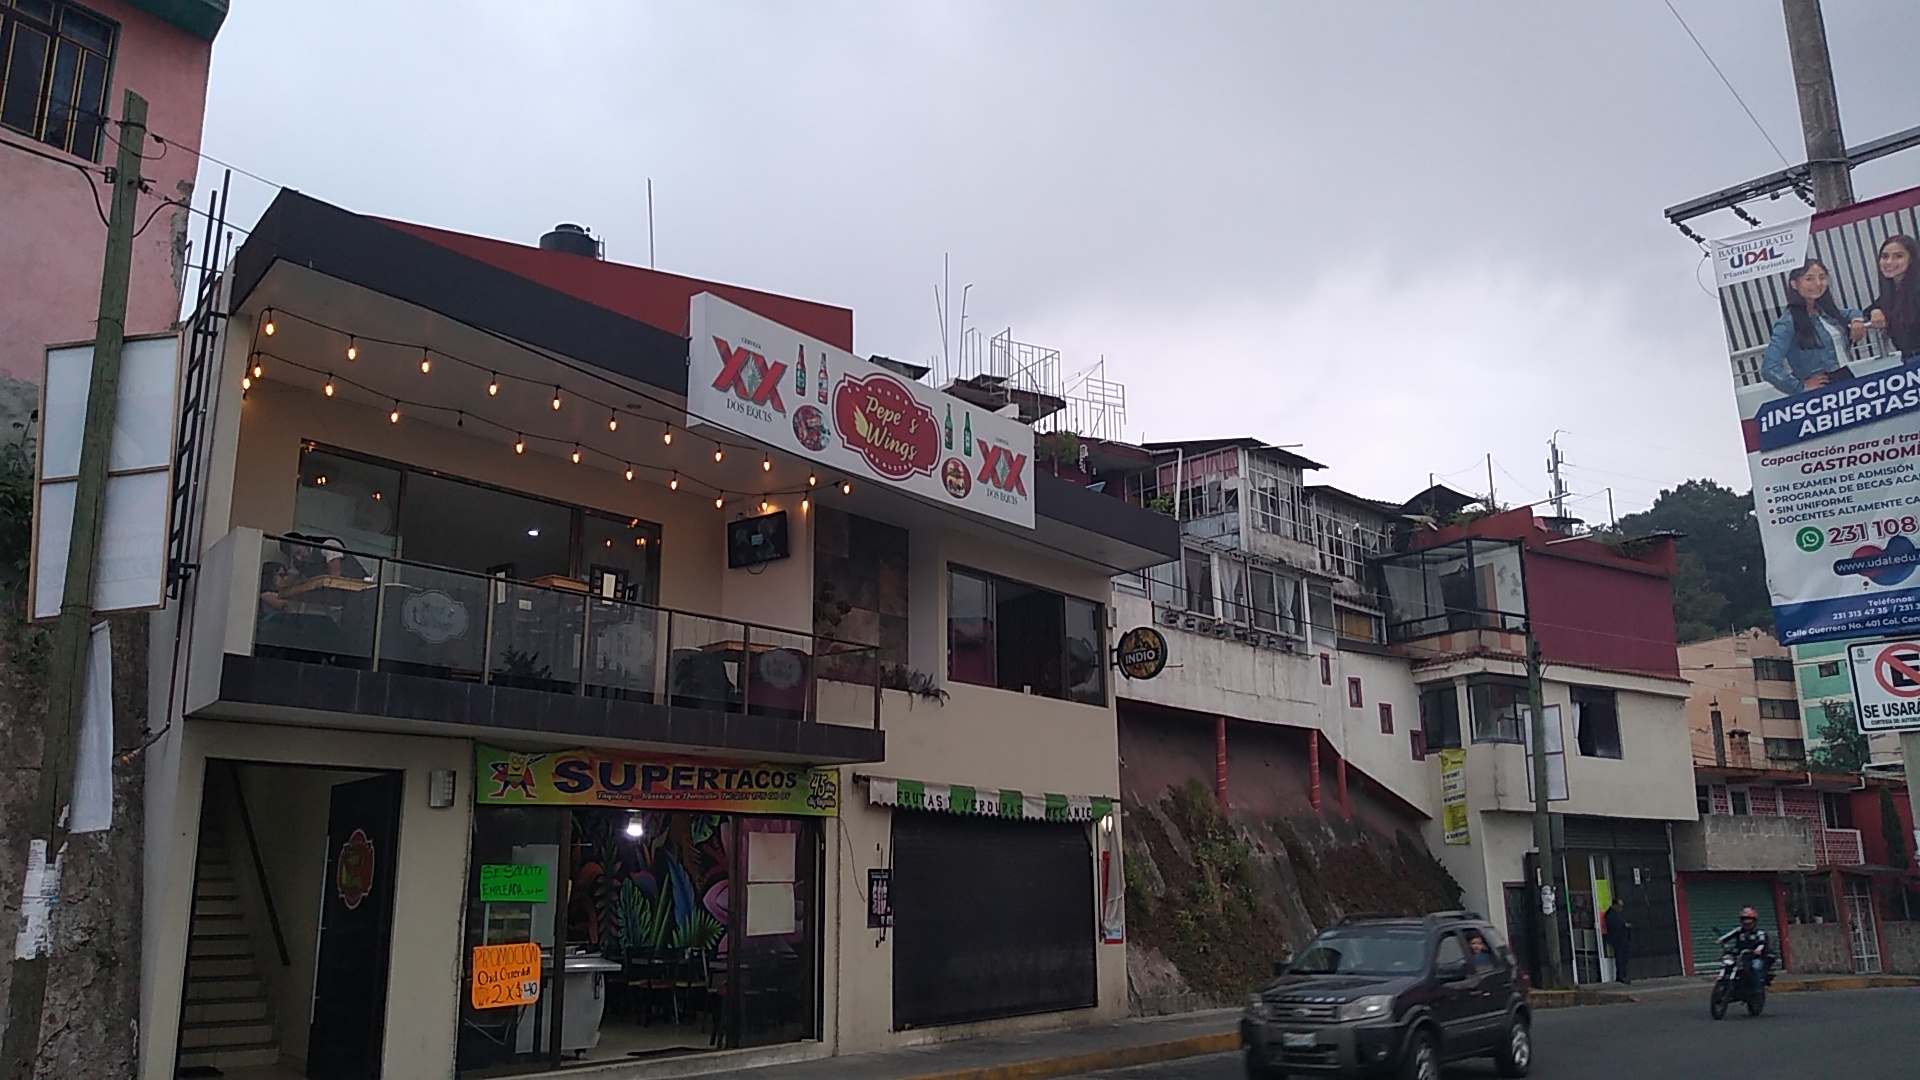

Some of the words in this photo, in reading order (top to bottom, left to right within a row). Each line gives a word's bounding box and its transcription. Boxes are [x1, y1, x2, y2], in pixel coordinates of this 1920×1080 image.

[1718, 233, 1794, 258] BACHILLERATO
[1730, 246, 1784, 268] UDAL
[1724, 268, 1753, 279] Plantel
[727, 398, 744, 413] DOS
[746, 405, 773, 422] EQUIS
[1798, 388, 1920, 437] ABIERTAS
[866, 422, 918, 461] Wings
[1761, 446, 1845, 467] Capacitación
[1849, 440, 1880, 453] para
[1883, 435, 1895, 445] el
[1773, 484, 1790, 493] SIN
[1793, 477, 1837, 490] EXAMEN
[1840, 473, 1855, 483] DE
[1858, 464, 1914, 480] ADMISIÓN
[1775, 488, 1836, 504] PROGRAMA
[1839, 484, 1855, 494] DE
[1857, 478, 1893, 491] BECAS
[1776, 505, 1794, 514] SIN
[1797, 496, 1853, 511] UNIFORME
[1779, 509, 1835, 524] DOCENTES
[1837, 499, 1902, 516] ALTAMENTE
[1828, 523, 1867, 544] 231
[1872, 516, 1917, 537] 108
[1867, 596, 1915, 607] Teléfonos:
[1848, 610, 1862, 618] 313
[1786, 629, 1807, 638] Calle
[1808, 625, 1847, 634] Guerrero
[1849, 622, 1864, 630] No.
[1865, 619, 1881, 627] 401
[1882, 617, 1900, 625] Col.
[1125, 650, 1156, 664] INDIO
[1864, 704, 1880, 718] SE
[553, 759, 798, 794] SUPERTACOS
[897, 791, 943, 807] FRUTAS
[962, 796, 1023, 815] VERDURAS
[483, 866, 500, 879] SE
[504, 866, 542, 879] SOLICITA
[482, 883, 522, 896] EMPLEADA
[474, 945, 538, 968] PROMOCION
[491, 984, 504, 1003] 2
